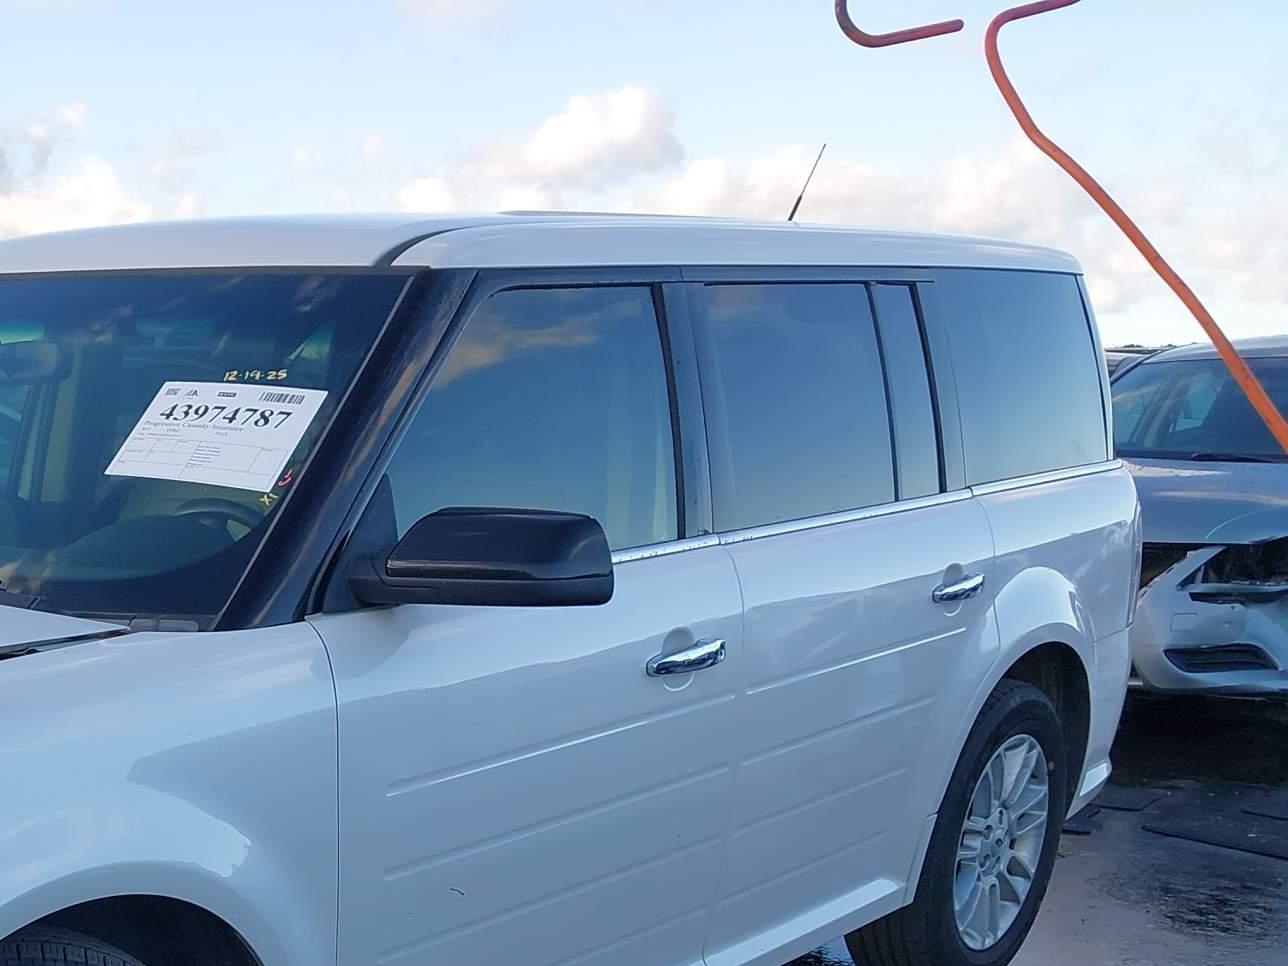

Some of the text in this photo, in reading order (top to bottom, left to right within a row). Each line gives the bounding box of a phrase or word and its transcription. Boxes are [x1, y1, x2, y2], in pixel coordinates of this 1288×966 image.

[159, 403, 293, 429] 43974787
[143, 420, 245, 432] Progressive Casualty Insurance
